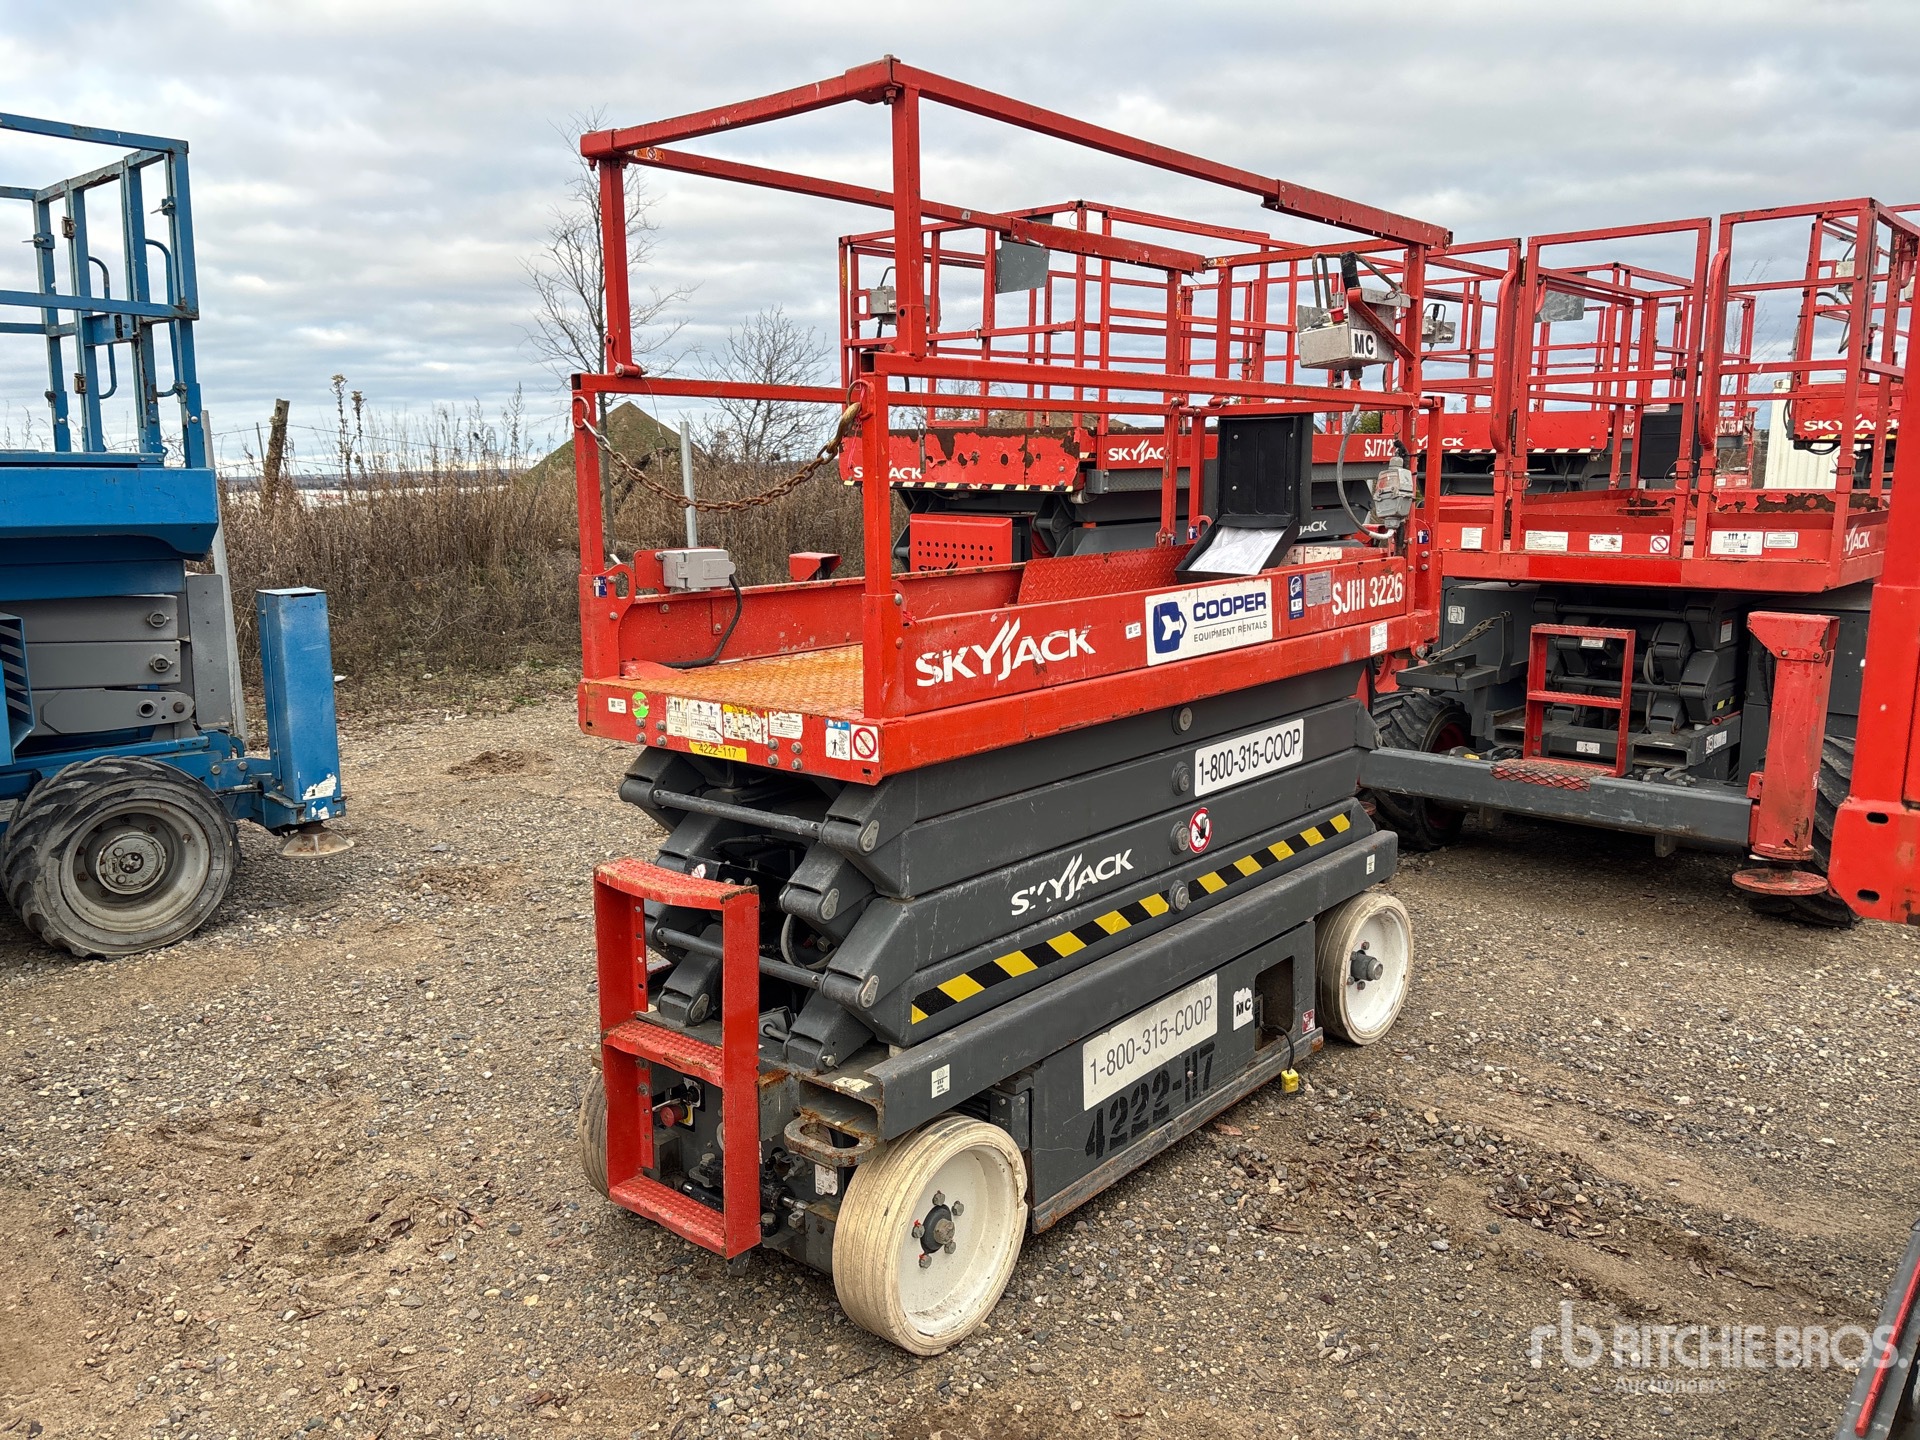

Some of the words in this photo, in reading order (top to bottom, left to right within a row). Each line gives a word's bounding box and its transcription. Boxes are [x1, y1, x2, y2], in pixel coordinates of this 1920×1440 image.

[1354, 333, 1374, 355] MC
[1108, 439, 1164, 464] SKYJAC
[1369, 572, 1403, 608] 3226
[1193, 591, 1267, 622] COOPER
[1193, 626, 1236, 643] EQUIPMENT
[1237, 619, 1268, 634] RENTALS
[915, 616, 1097, 687] SKYJACK
[698, 743, 737, 758] 4222-117
[1199, 728, 1301, 786] 1-800-315-COOP
[1236, 997, 1252, 1018] MC
[1090, 995, 1213, 1086] 1-800-315-COOP
[1085, 1041, 1216, 1160] 4222-117
